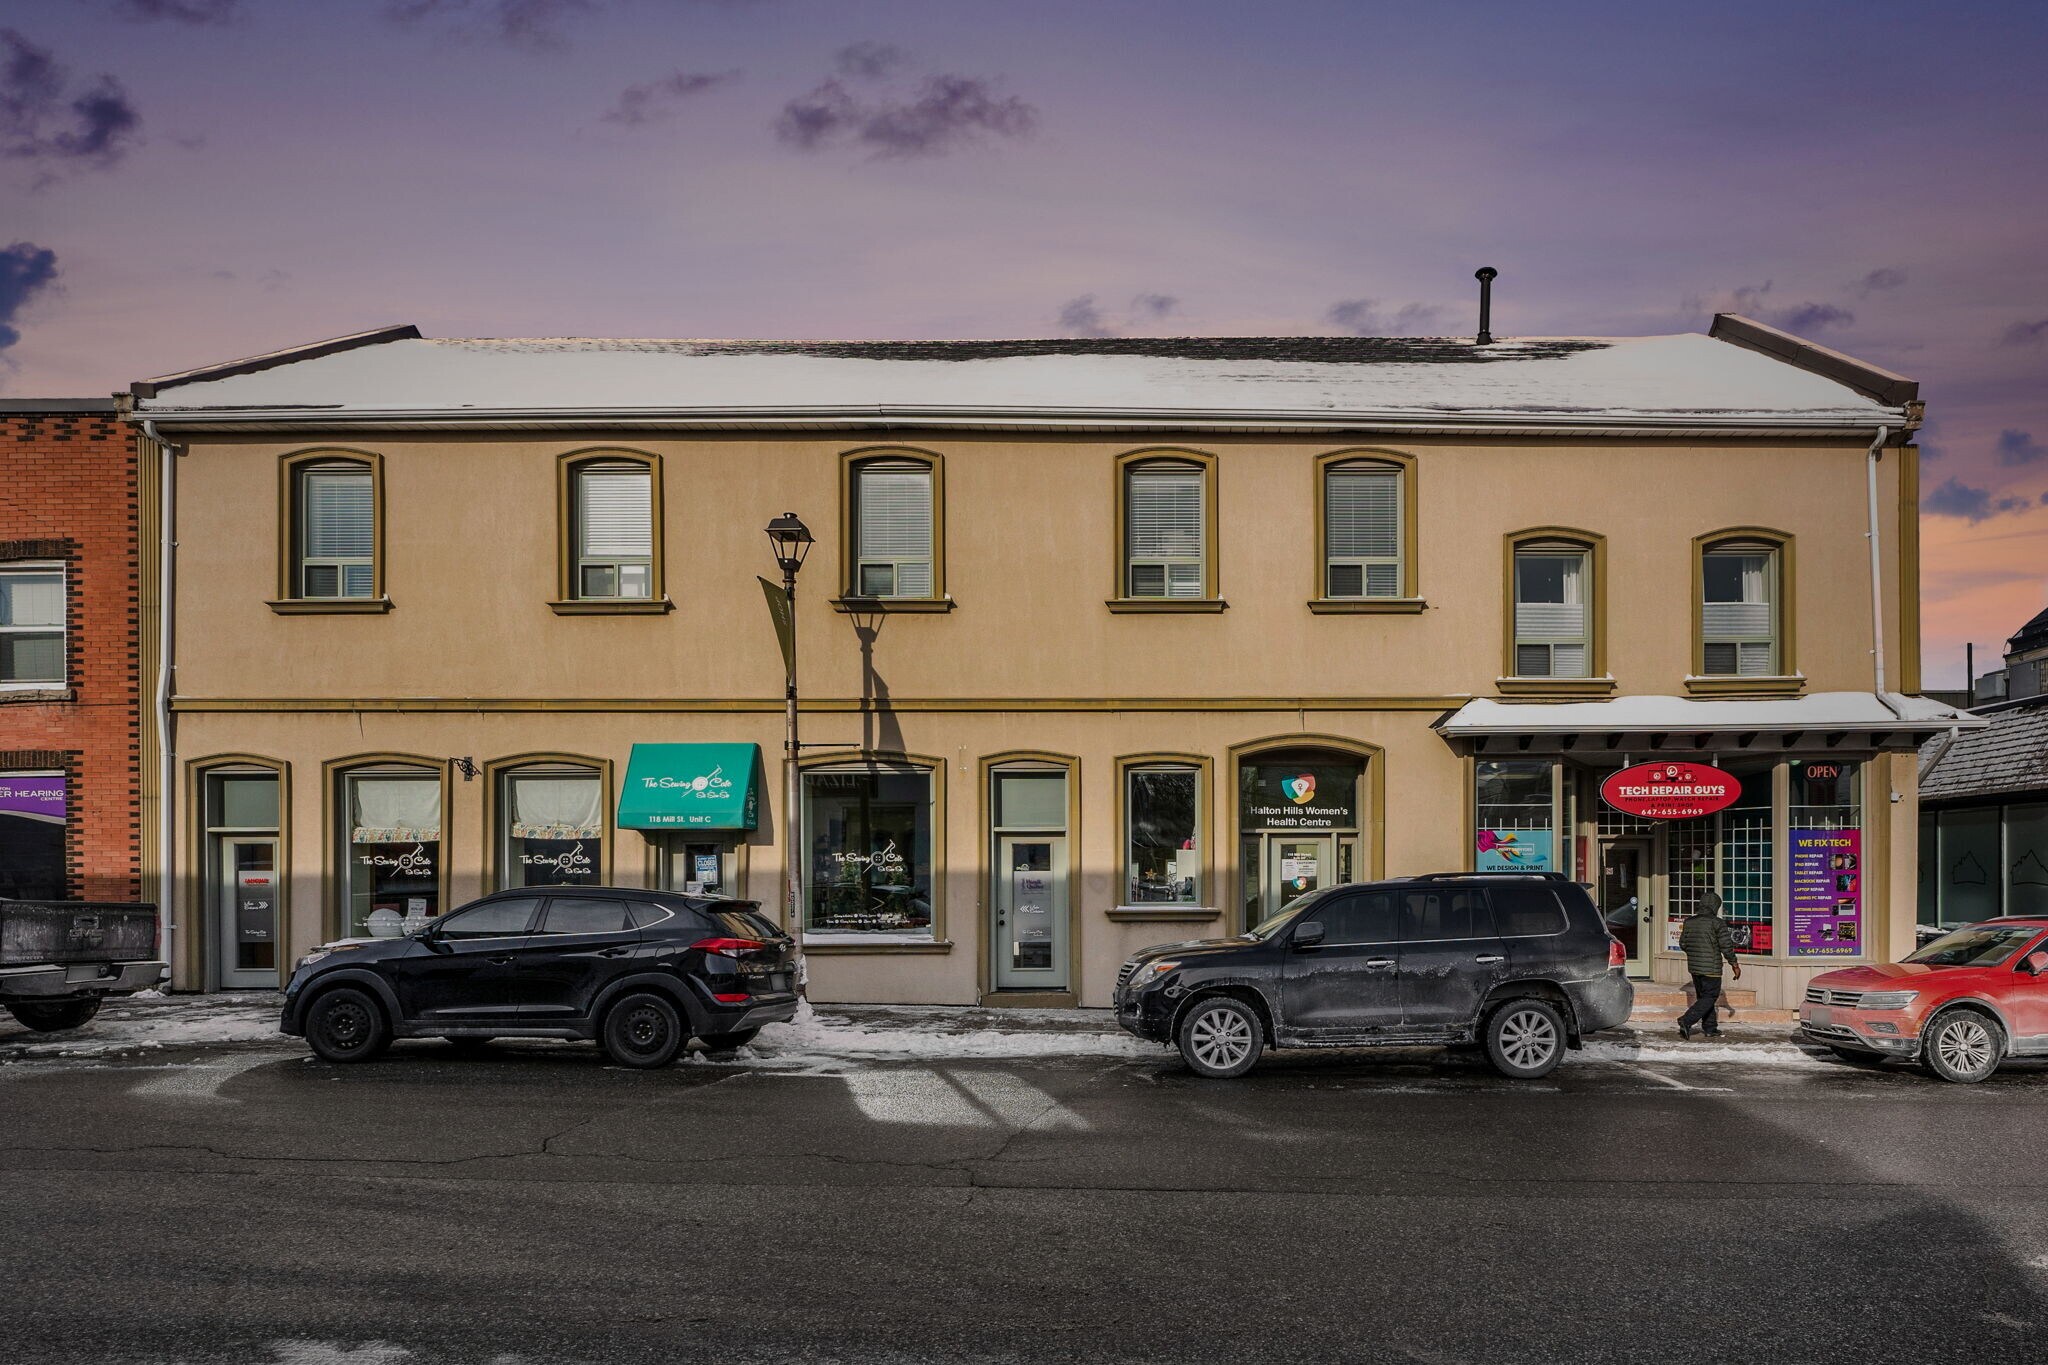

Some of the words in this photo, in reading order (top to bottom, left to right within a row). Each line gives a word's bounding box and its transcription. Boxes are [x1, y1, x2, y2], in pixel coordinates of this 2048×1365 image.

[1807, 765, 1838, 778] OPEN
[641, 777, 658, 788] The
[659, 777, 692, 789] Sewing
[1618, 786, 1649, 796] TECH
[1651, 785, 1692, 795] REPAIR
[1693, 785, 1725, 794] GUYS
[1250, 806, 1281, 815] Halton
[1283, 806, 1304, 815] Hills
[1305, 806, 1349, 815] Women's
[649, 815, 660, 823] 118
[662, 815, 676, 823] Mill
[677, 815, 686, 823] St.
[689, 815, 703, 823] Unit
[704, 815, 711, 823] C
[1266, 818, 1298, 826] Health
[1299, 818, 1332, 826] Centre
[1798, 839, 1813, 847] WE
[1814, 839, 1828, 847] FIX
[1829, 839, 1852, 847] TECH
[359, 855, 374, 865] The
[374, 855, 399, 867] Sewing
[518, 854, 533, 864] The
[533, 854, 558, 866] Sewing
[831, 852, 846, 862] The
[846, 852, 871, 863] Sewing
